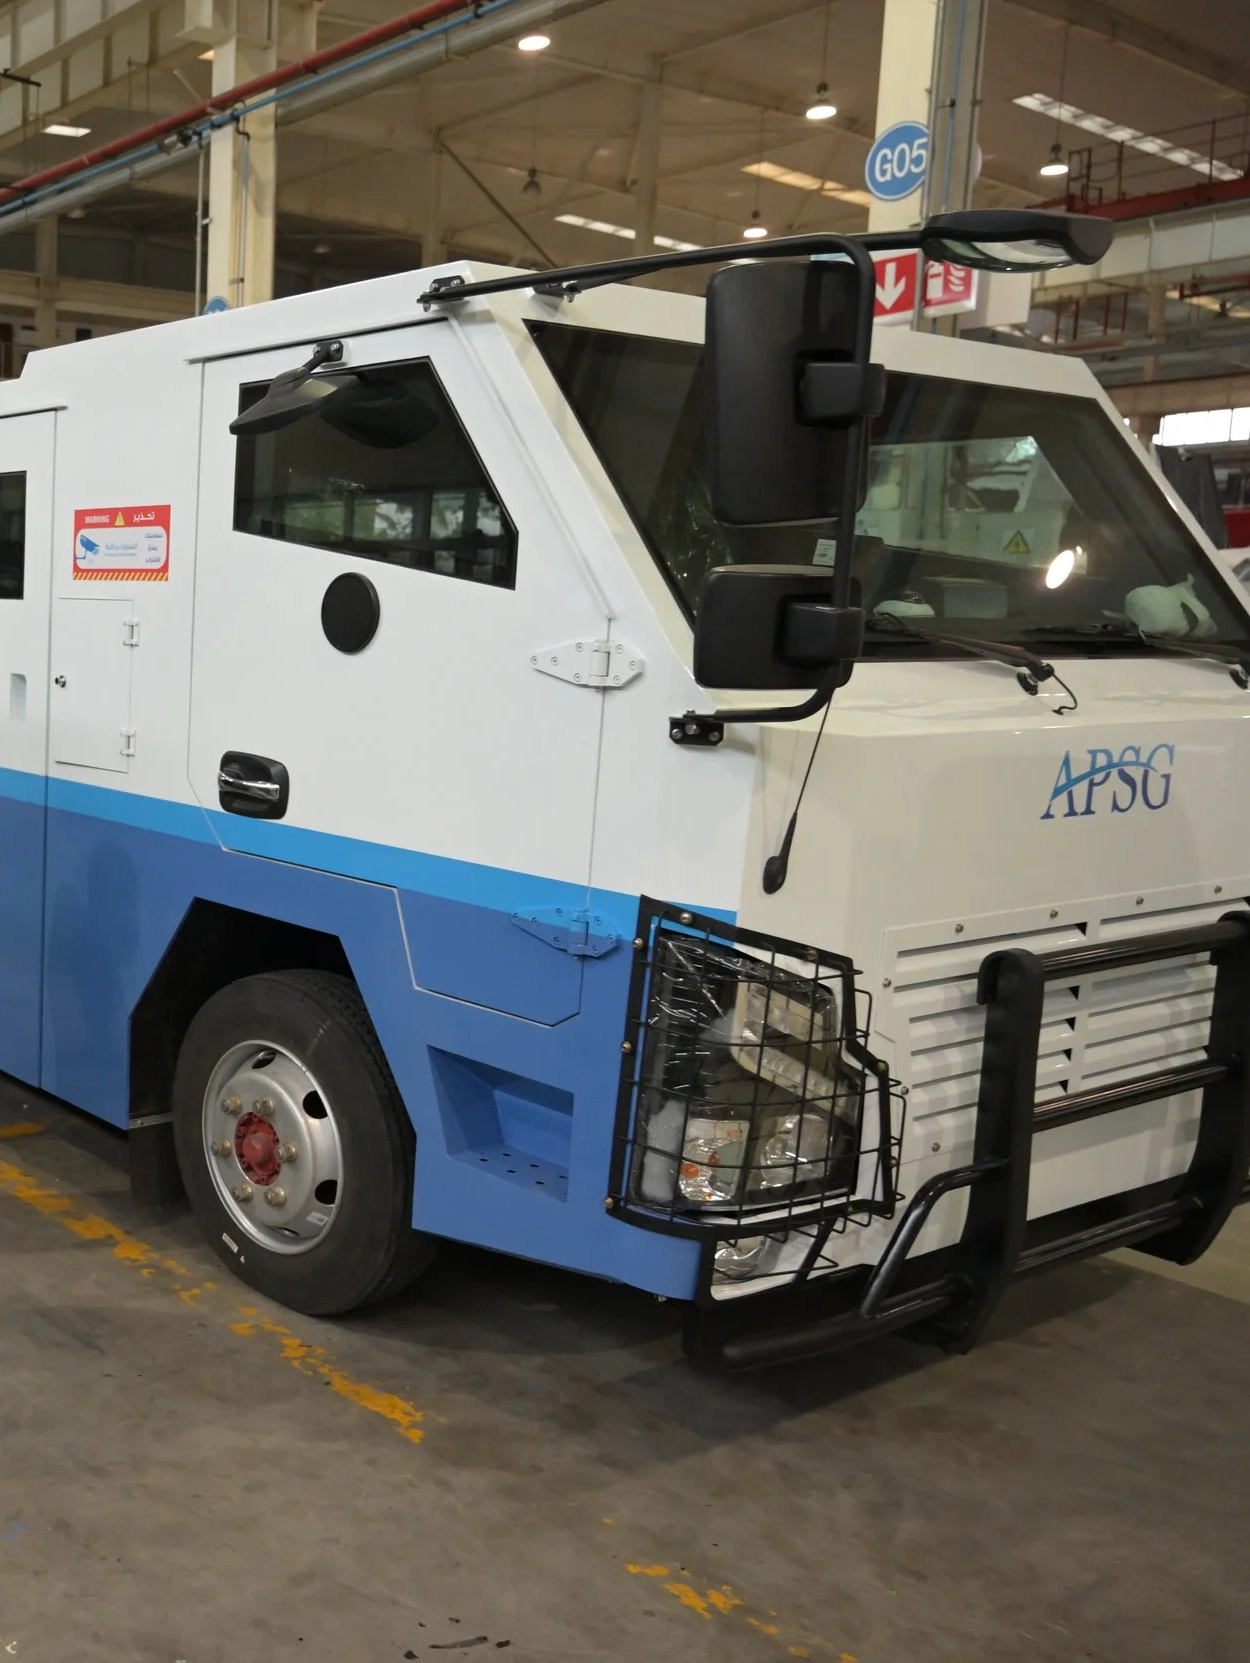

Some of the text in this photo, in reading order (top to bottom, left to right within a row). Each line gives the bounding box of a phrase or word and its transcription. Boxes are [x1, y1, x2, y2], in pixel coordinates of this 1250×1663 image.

[874, 137, 928, 183] G05
[84, 515, 110, 524] WARNING
[1040, 743, 1175, 820] APSG
